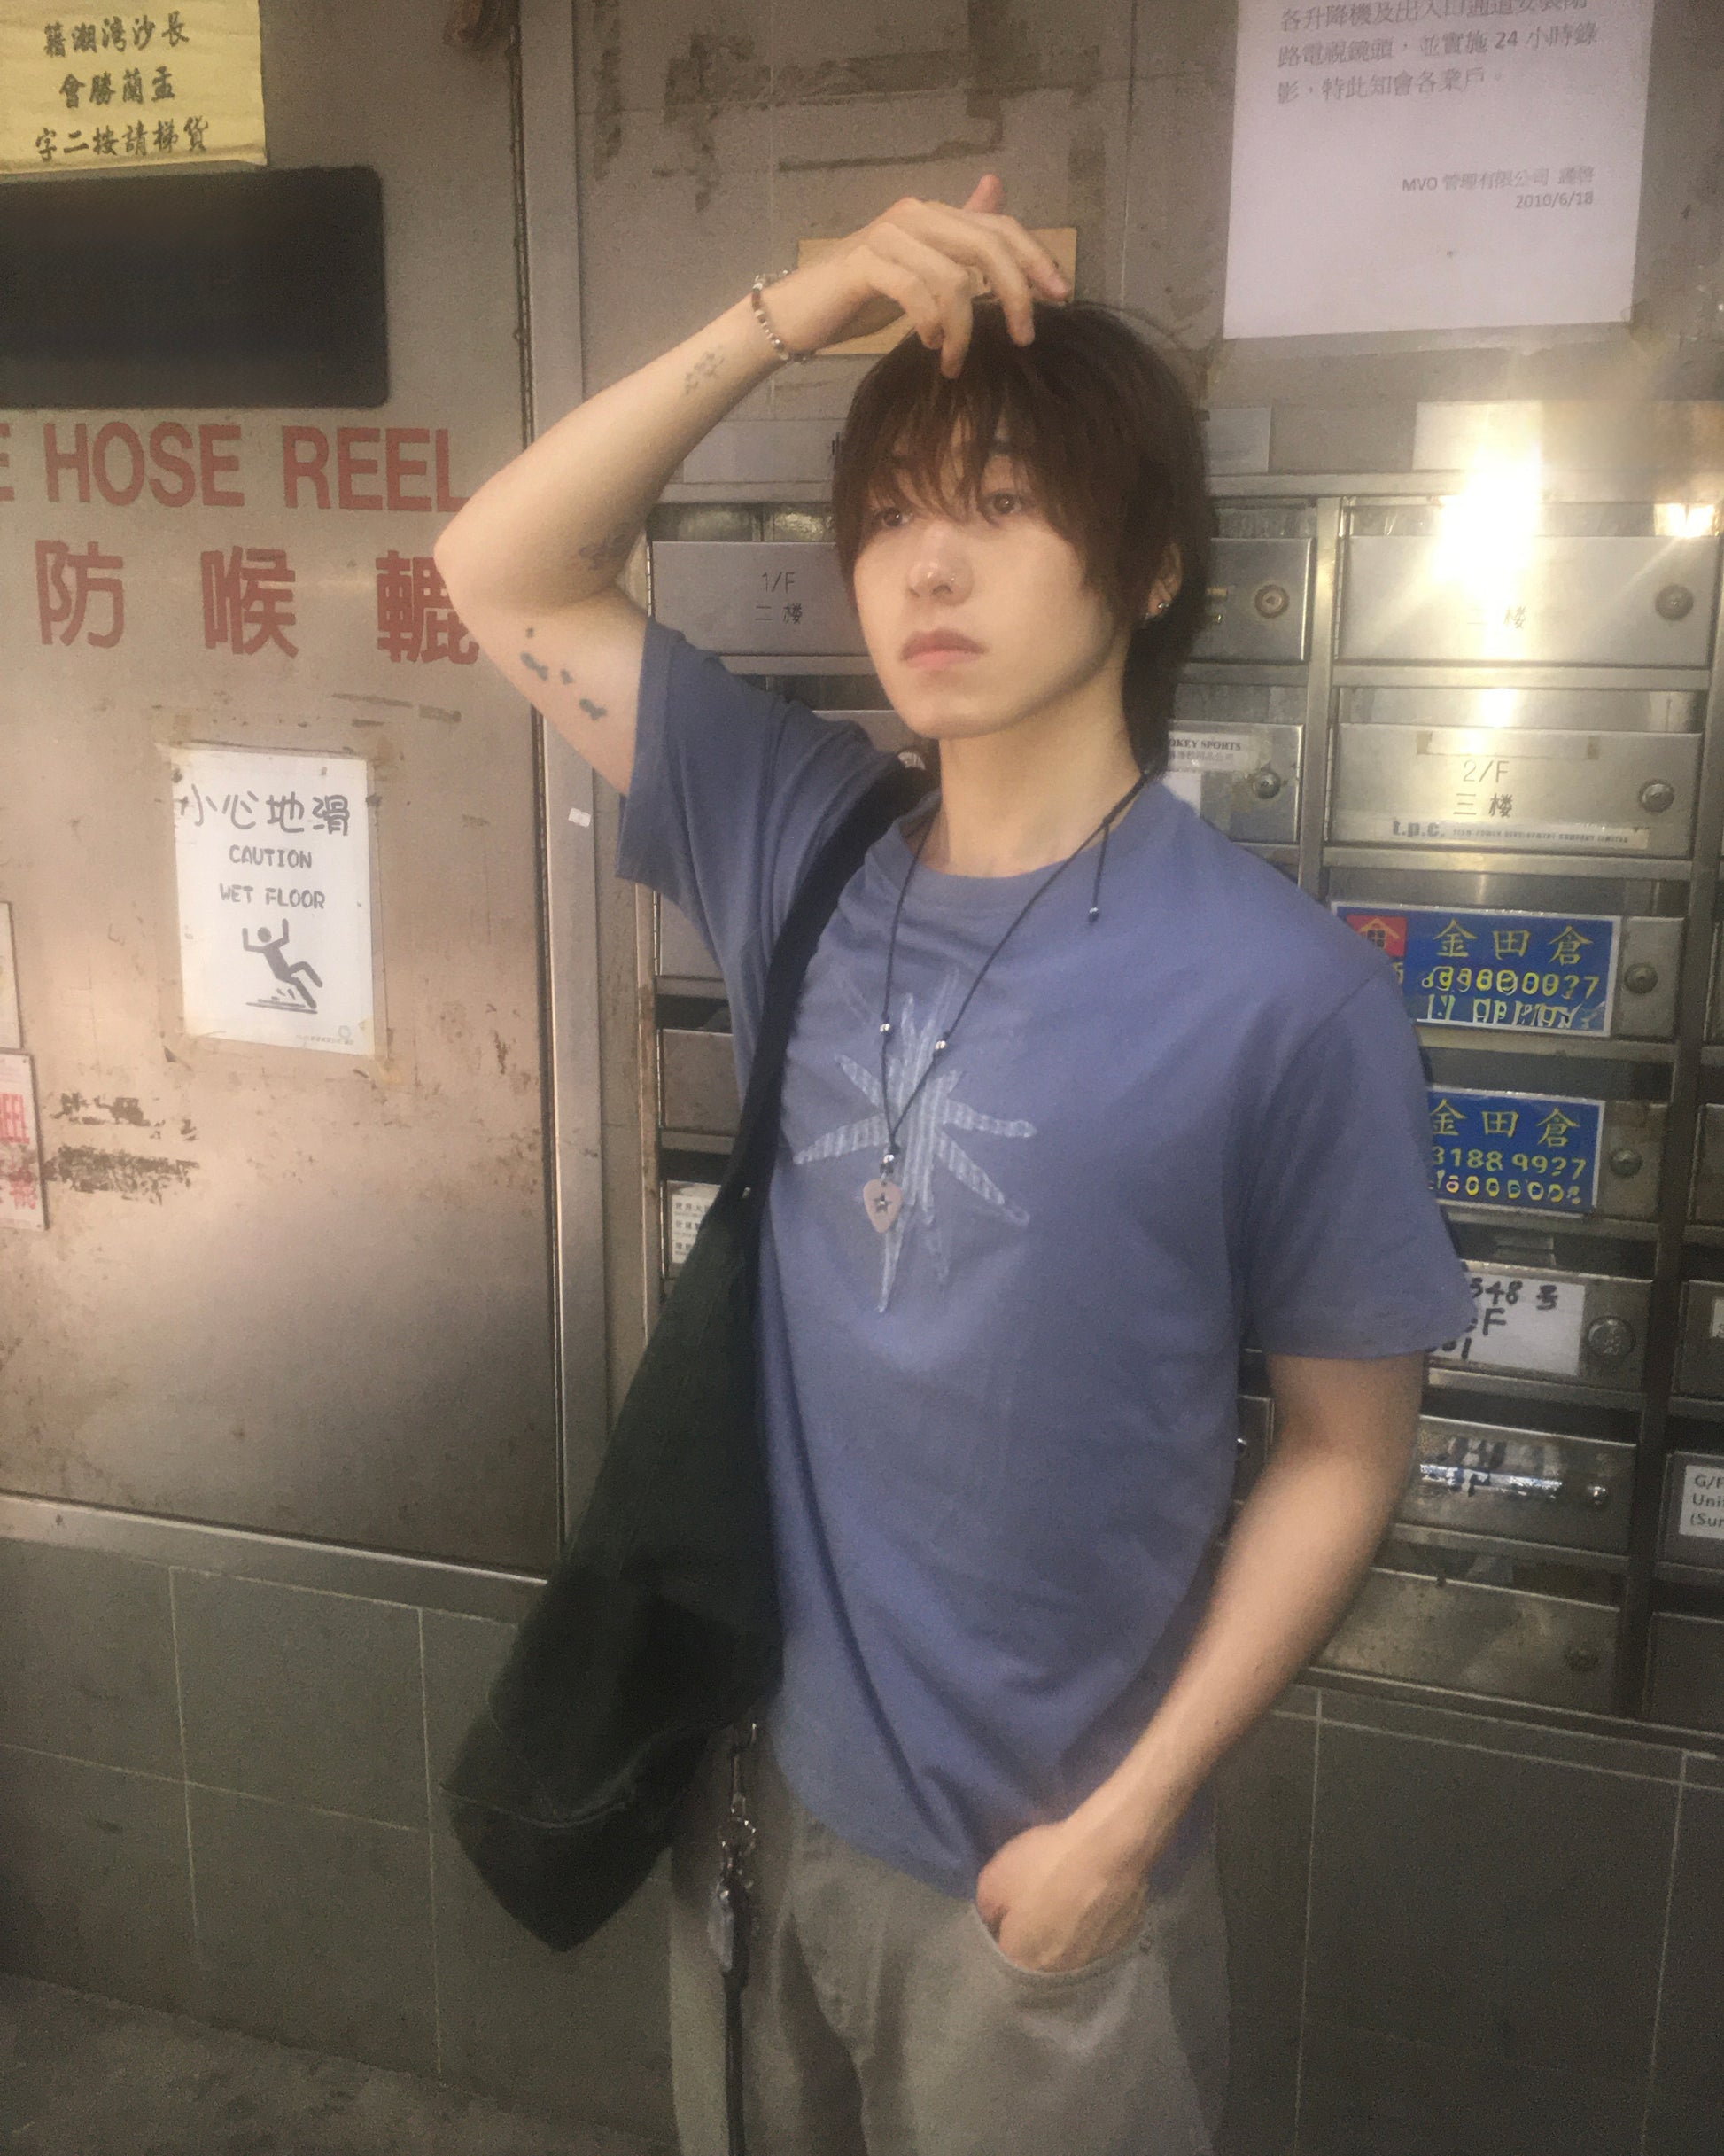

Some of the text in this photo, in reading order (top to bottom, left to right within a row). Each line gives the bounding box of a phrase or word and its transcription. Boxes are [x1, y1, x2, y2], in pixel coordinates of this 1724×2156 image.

[1495, 30, 1518, 50] 24
[43, 422, 245, 507] HOSE
[282, 425, 471, 513] REEL
[761, 572, 796, 594] 1/F
[1201, 740, 1241, 751] SPORTS
[1463, 759, 1510, 783] 2/F
[181, 783, 350, 836] 小心地滑
[229, 844, 312, 868] CAUTION
[220, 883, 325, 910] WET FLOOR
[1433, 918, 1594, 967] 金田倉
[1429, 1098, 1580, 1148] 金田倉
